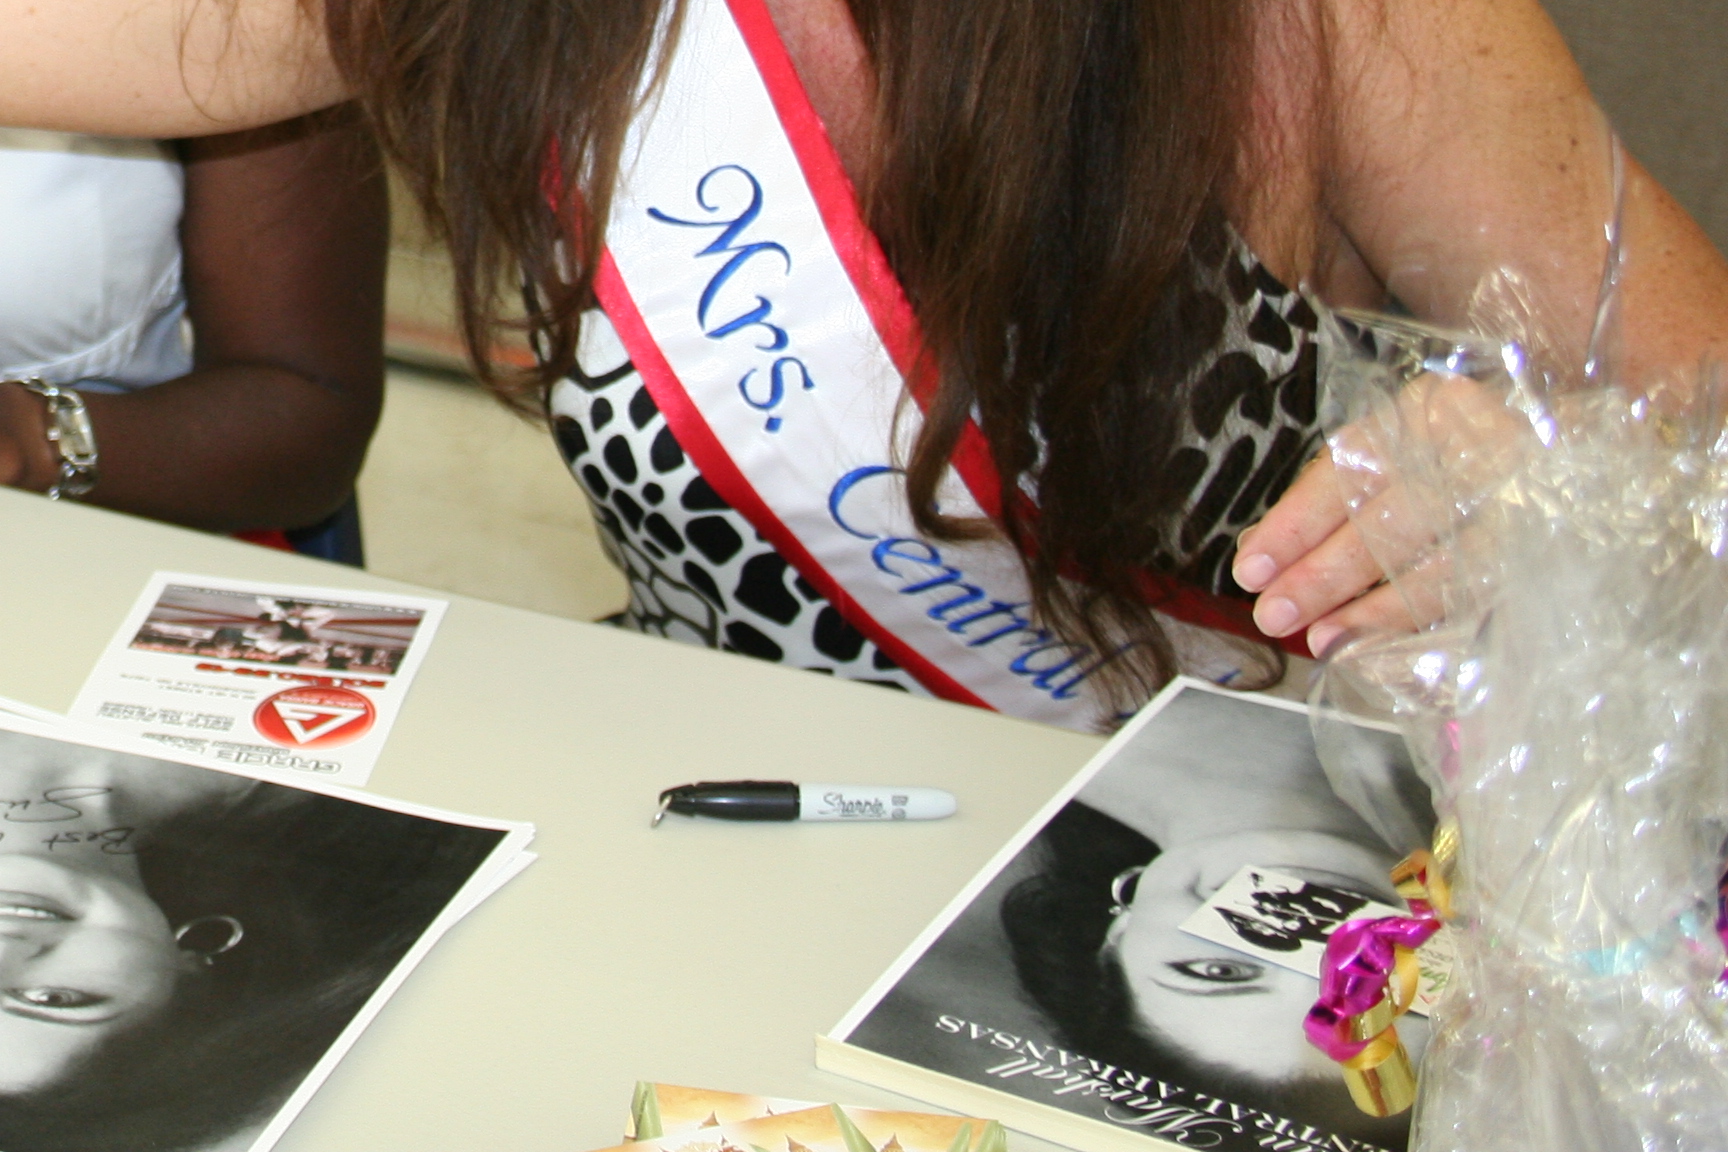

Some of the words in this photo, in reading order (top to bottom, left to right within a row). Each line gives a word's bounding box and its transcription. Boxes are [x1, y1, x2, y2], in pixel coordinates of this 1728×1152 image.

[646, 164, 814, 434] Mrs.
[828, 465, 1131, 701] Central
[41, 827, 139, 855] Best
[935, 1014, 1187, 1100] ARKANSAS
[985, 1056, 1244, 1149] Marshall
